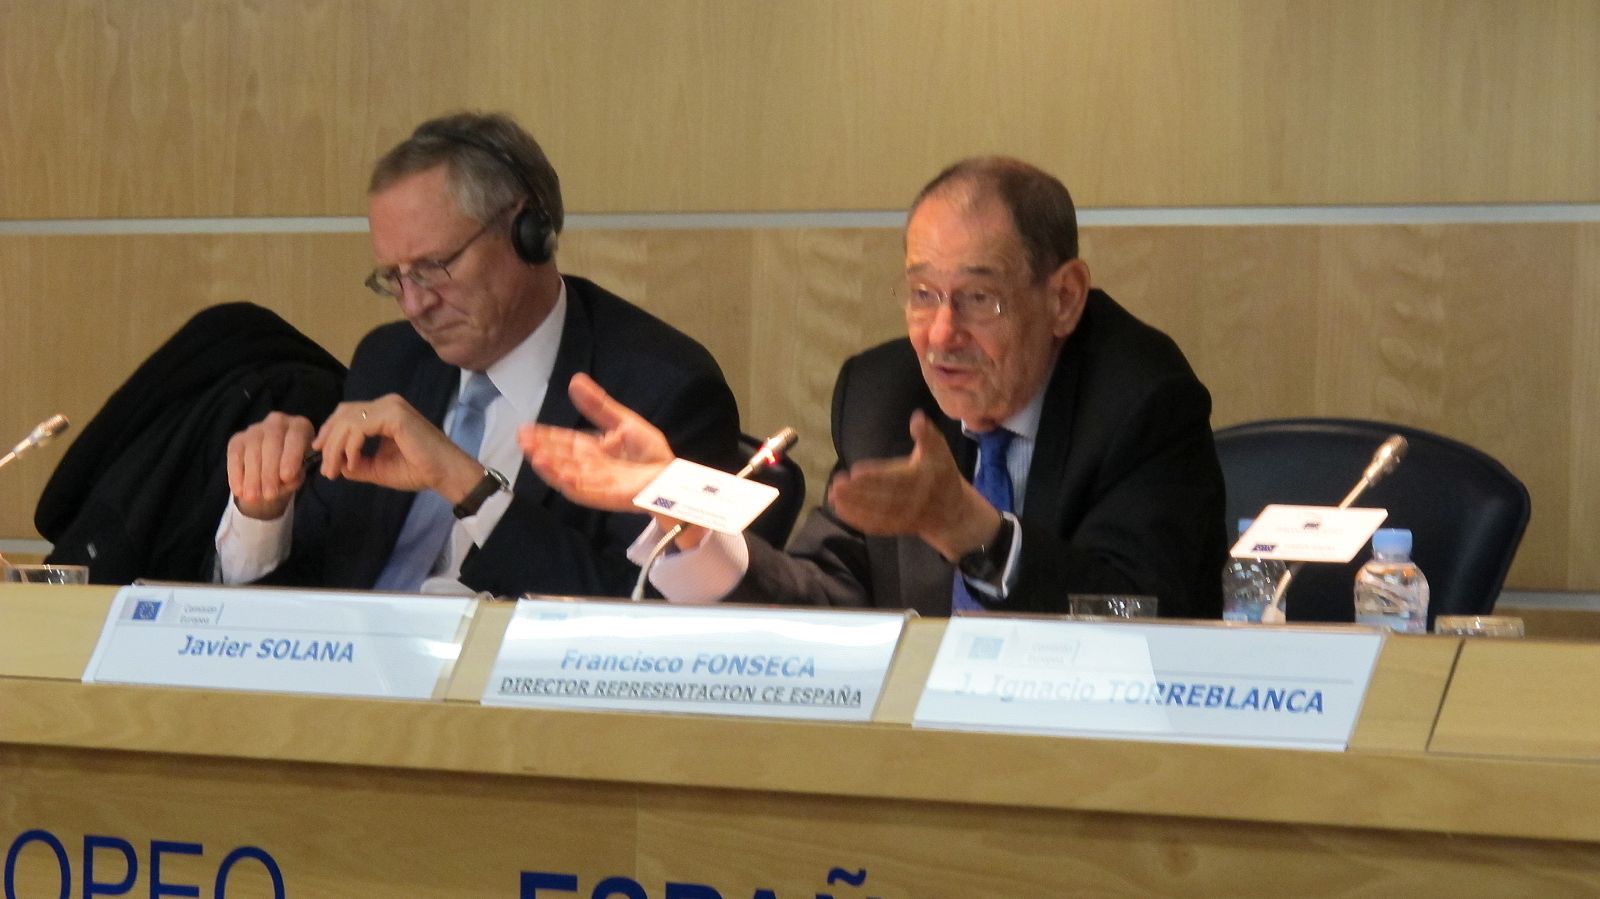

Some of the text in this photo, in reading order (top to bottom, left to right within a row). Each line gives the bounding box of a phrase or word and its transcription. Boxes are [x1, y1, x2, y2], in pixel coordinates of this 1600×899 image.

[178, 634, 354, 664] Javier SOLANA
[560, 649, 816, 678] Francisco FONSECA
[499, 677, 863, 708] DIRECTOR REPRESENTACION CE ESPAÑA
[1108, 681, 1325, 714] TORREBLANCA
